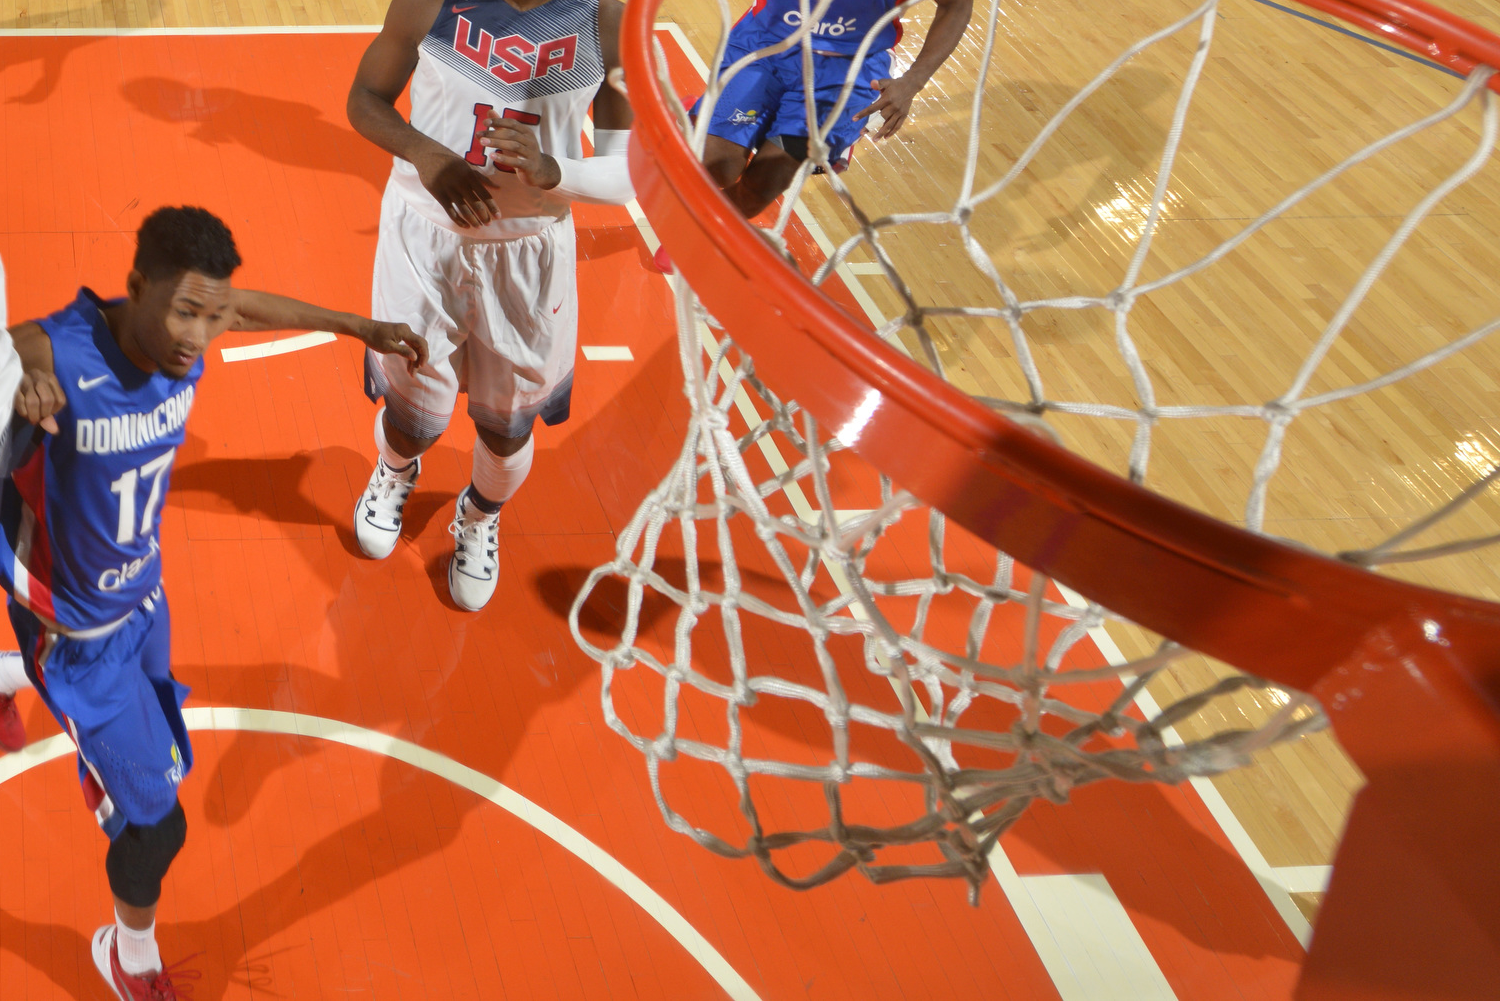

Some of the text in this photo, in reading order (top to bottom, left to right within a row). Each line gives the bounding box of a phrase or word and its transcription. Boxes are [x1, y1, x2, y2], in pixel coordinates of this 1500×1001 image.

[453, 14, 579, 85] USA
[783, 10, 845, 36] Caro
[111, 447, 176, 545] 17
